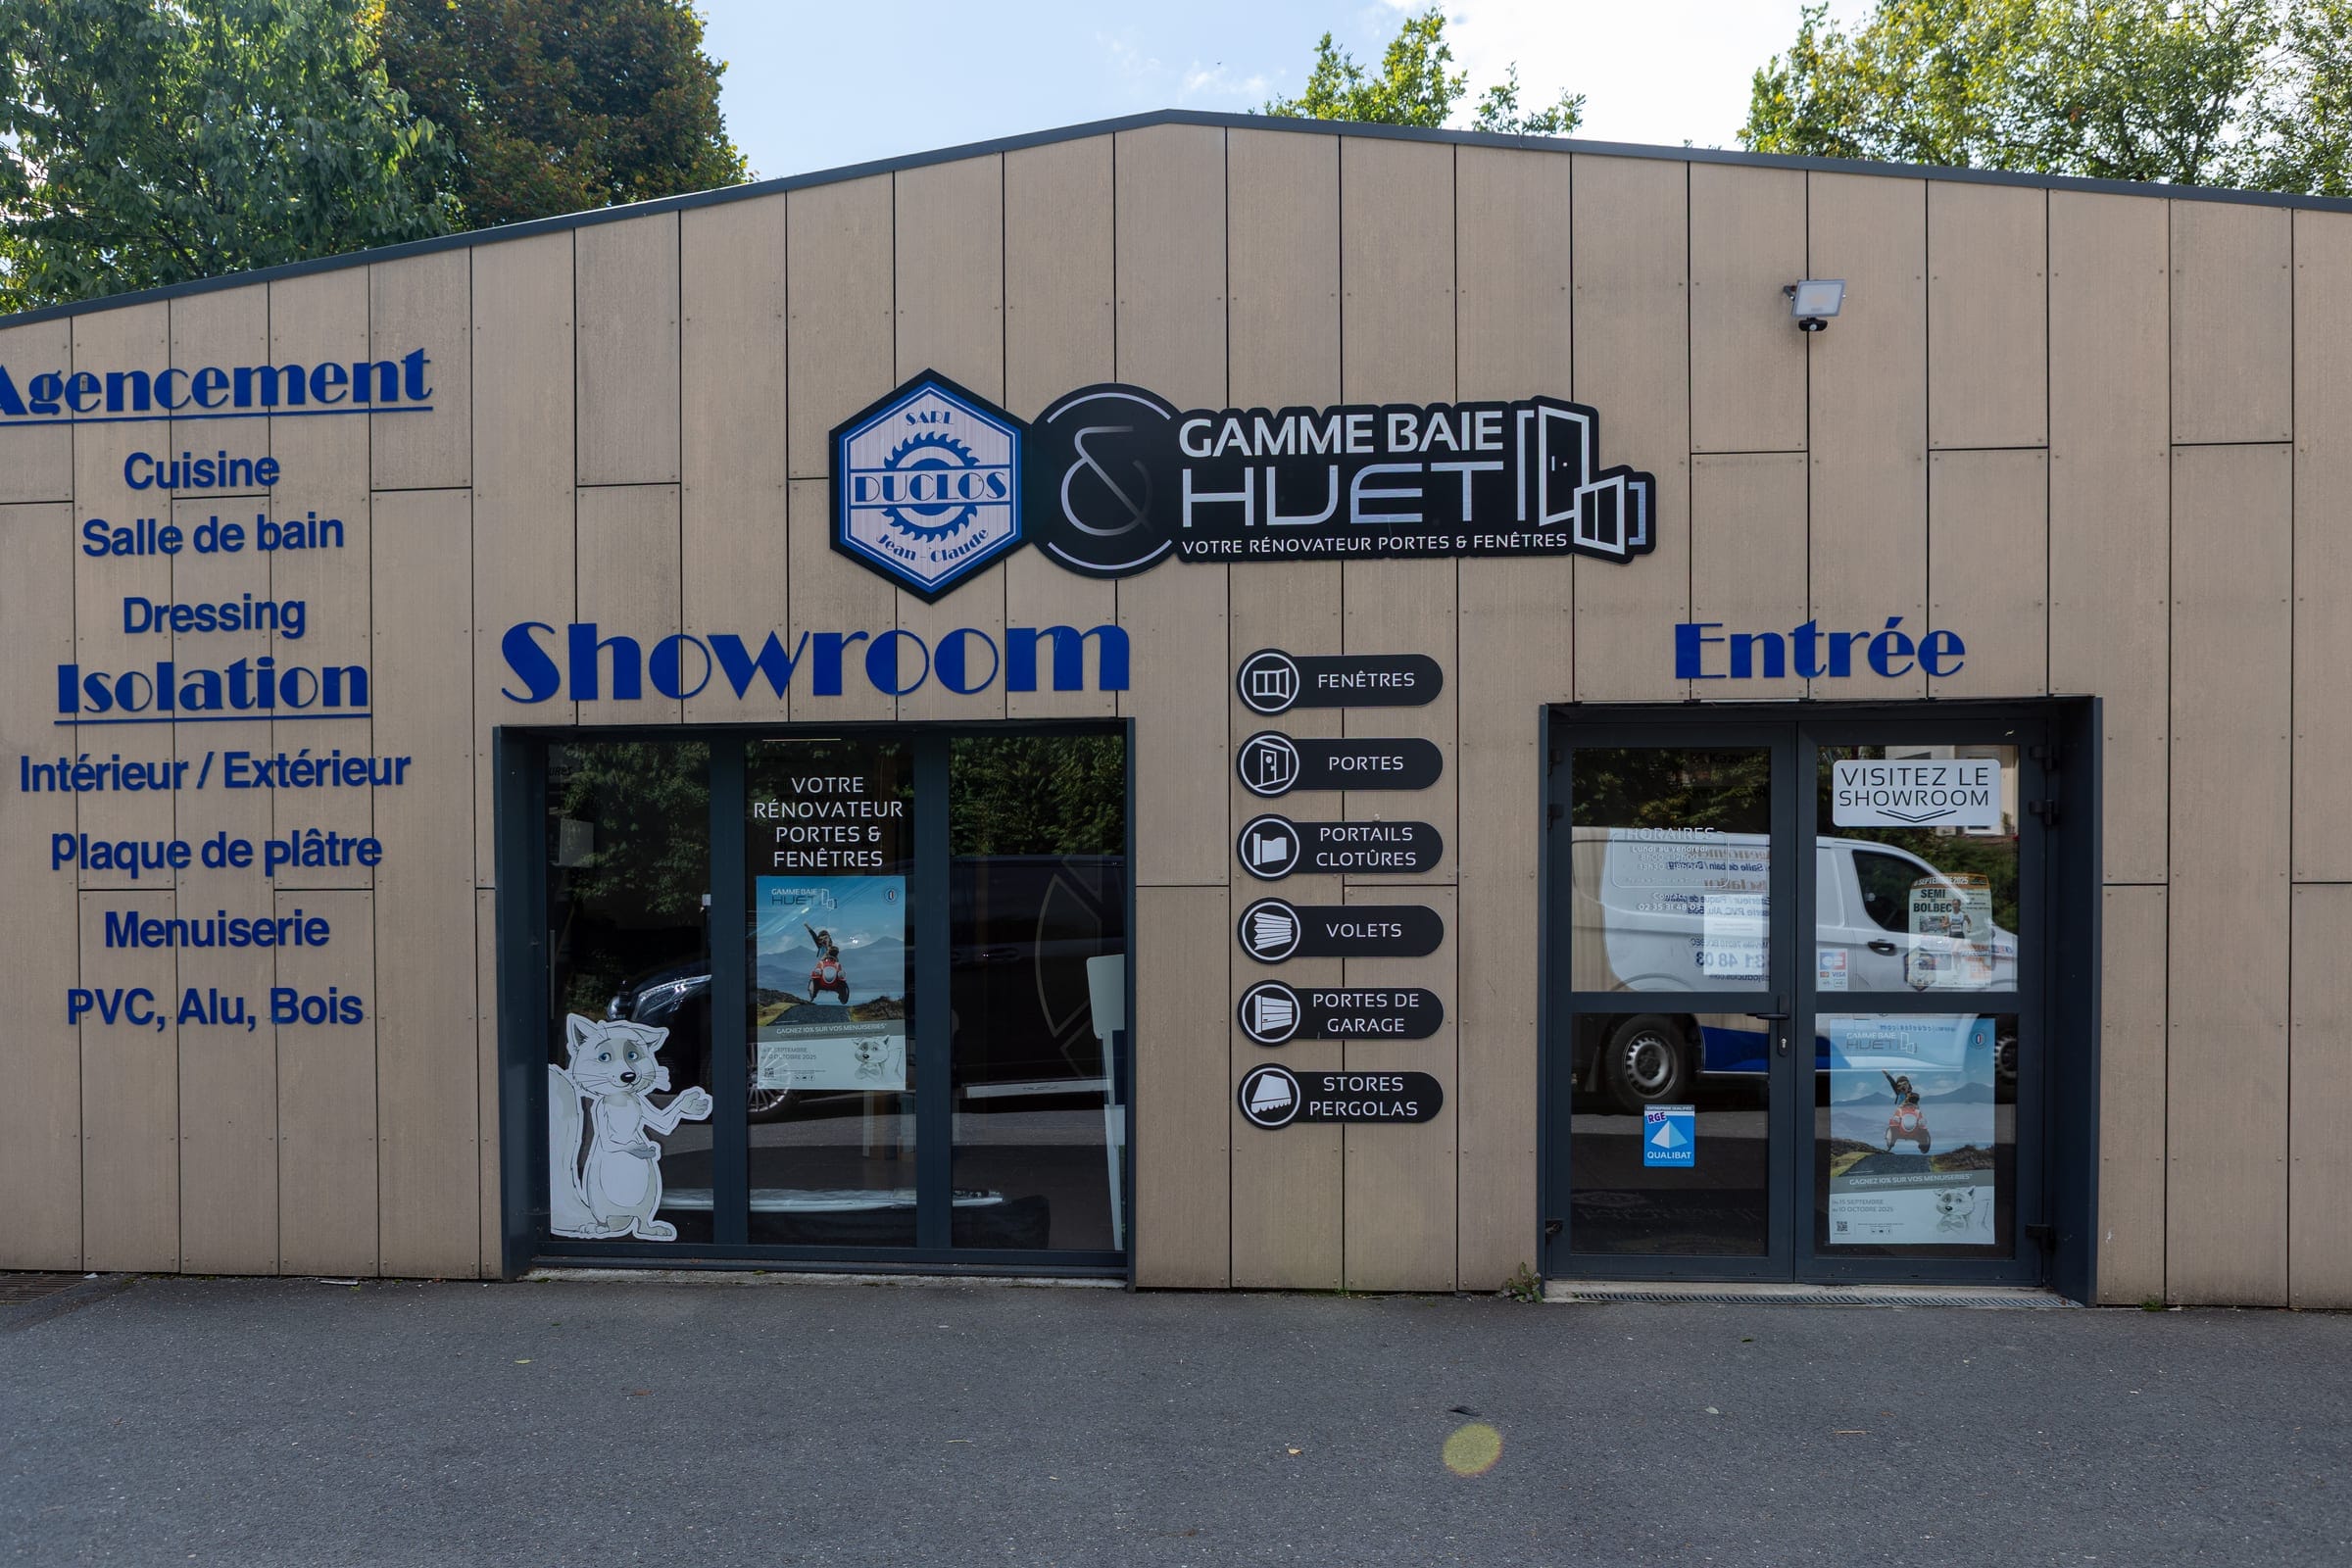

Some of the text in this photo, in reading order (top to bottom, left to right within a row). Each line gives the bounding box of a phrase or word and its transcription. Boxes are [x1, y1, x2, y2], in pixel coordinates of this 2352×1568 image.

[0, 347, 433, 416] Agencement
[906, 410, 955, 426] SARL
[1179, 410, 1504, 458] GAMME BAIE
[124, 450, 280, 491] Cuisine
[855, 471, 1007, 503] DUCLOS
[1182, 461, 1504, 527] HUET
[82, 511, 344, 557] Salle de bain
[1182, 530, 1567, 555] VOTRE RÉNOVATEUR PORTES & FENÊTRES
[876, 532, 917, 562] Jean
[930, 527, 990, 563] Claude
[123, 593, 307, 640] Dressing
[1675, 616, 1966, 679] Entrée
[501, 620, 1131, 704] Showroom
[57, 656, 369, 713] Isolation
[1318, 669, 1416, 689] FENÊTRES
[21, 749, 412, 792] Intérieur / Extérieur
[1329, 756, 1404, 771] PORTES
[791, 776, 864, 794] VOTRE
[1840, 766, 1989, 787] VISITEZ LE
[754, 798, 904, 819] RÉNOVATEUR
[1838, 789, 1989, 808] SHOWROOM
[775, 825, 882, 843] PORTES &
[1319, 827, 1414, 843] PORTAILS
[1627, 827, 1715, 840] HORAIRES
[202, 831, 253, 868] de
[265, 827, 383, 877] plâtre
[773, 847, 883, 868] FENÊTRES
[1315, 849, 1417, 867] CLOTÛRES
[1921, 889, 1945, 899] SEMI
[1913, 903, 1952, 913] BOLBEC
[105, 908, 330, 948] Menuiserie
[1326, 922, 1403, 939] VOLETS
[68, 985, 364, 1032] PVC, Alu, Bois
[1312, 993, 1420, 1008] PORTES DE
[1327, 1017, 1405, 1033] GARAGE
[1323, 1076, 1404, 1092] STORES
[1309, 1100, 1418, 1116] PERGOLAS
[1647, 1112, 1666, 1123] RGE
